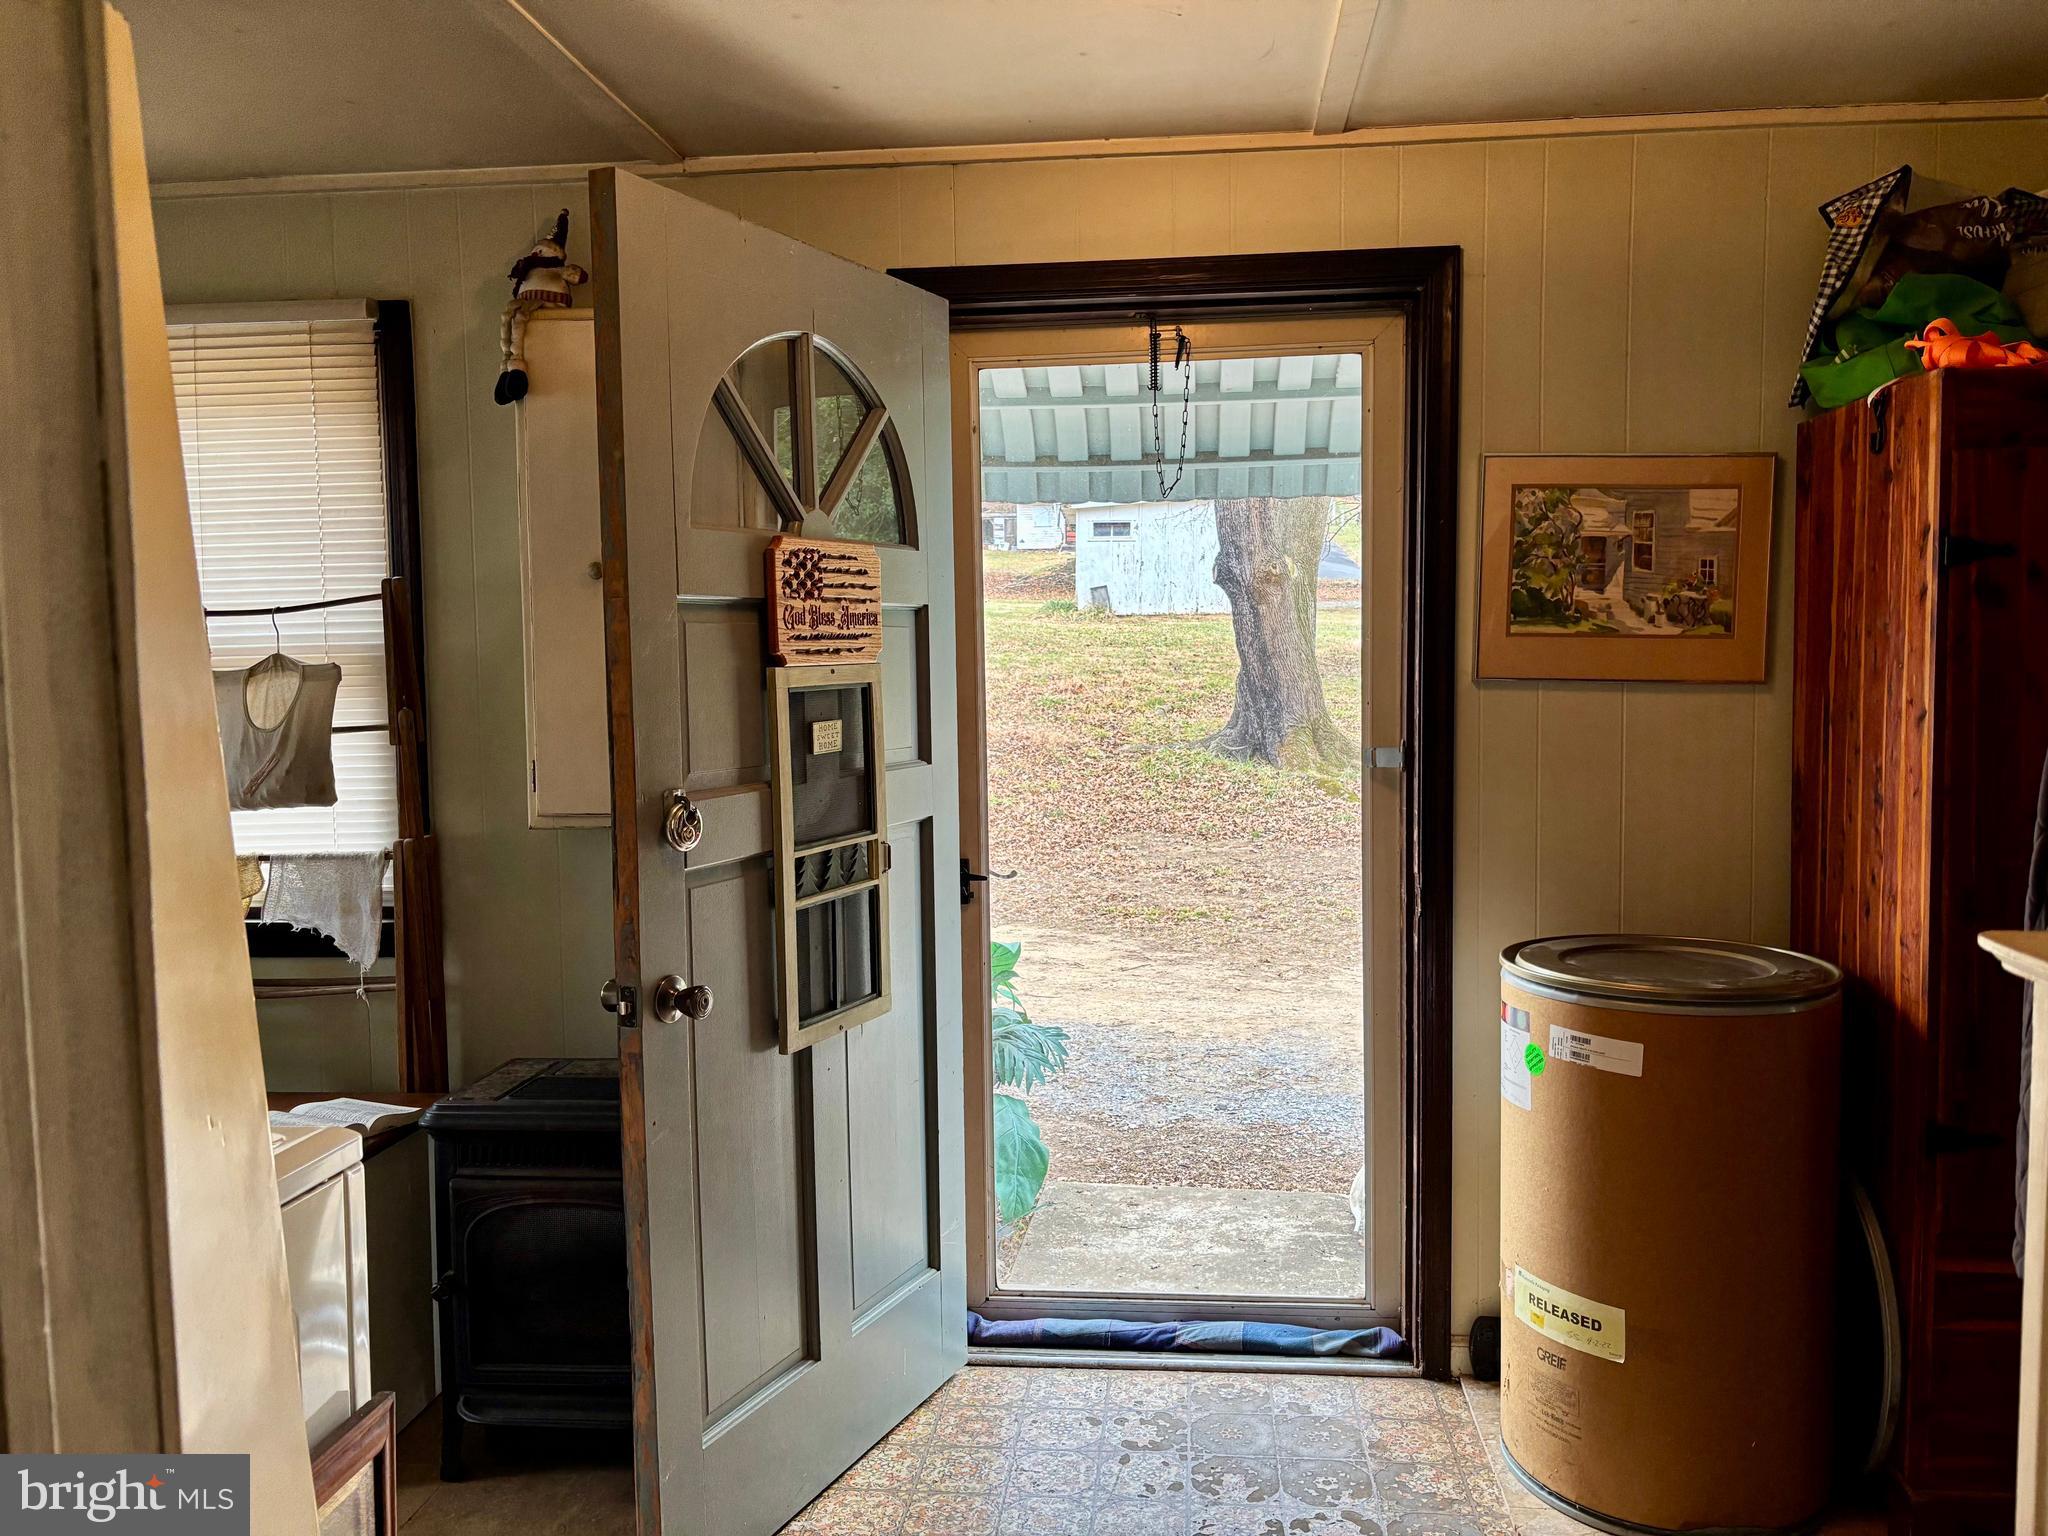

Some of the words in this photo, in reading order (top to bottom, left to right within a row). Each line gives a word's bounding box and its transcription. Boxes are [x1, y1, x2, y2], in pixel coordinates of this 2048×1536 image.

[783, 604, 806, 630] God
[808, 604, 836, 630] Bless
[837, 605, 879, 630] America
[816, 731, 840, 741] SWEET
[818, 722, 838, 732] HOME
[818, 739, 838, 750] HOME
[1528, 1292, 1603, 1332] RELEASED
[1536, 1346, 1568, 1371] GREIF
